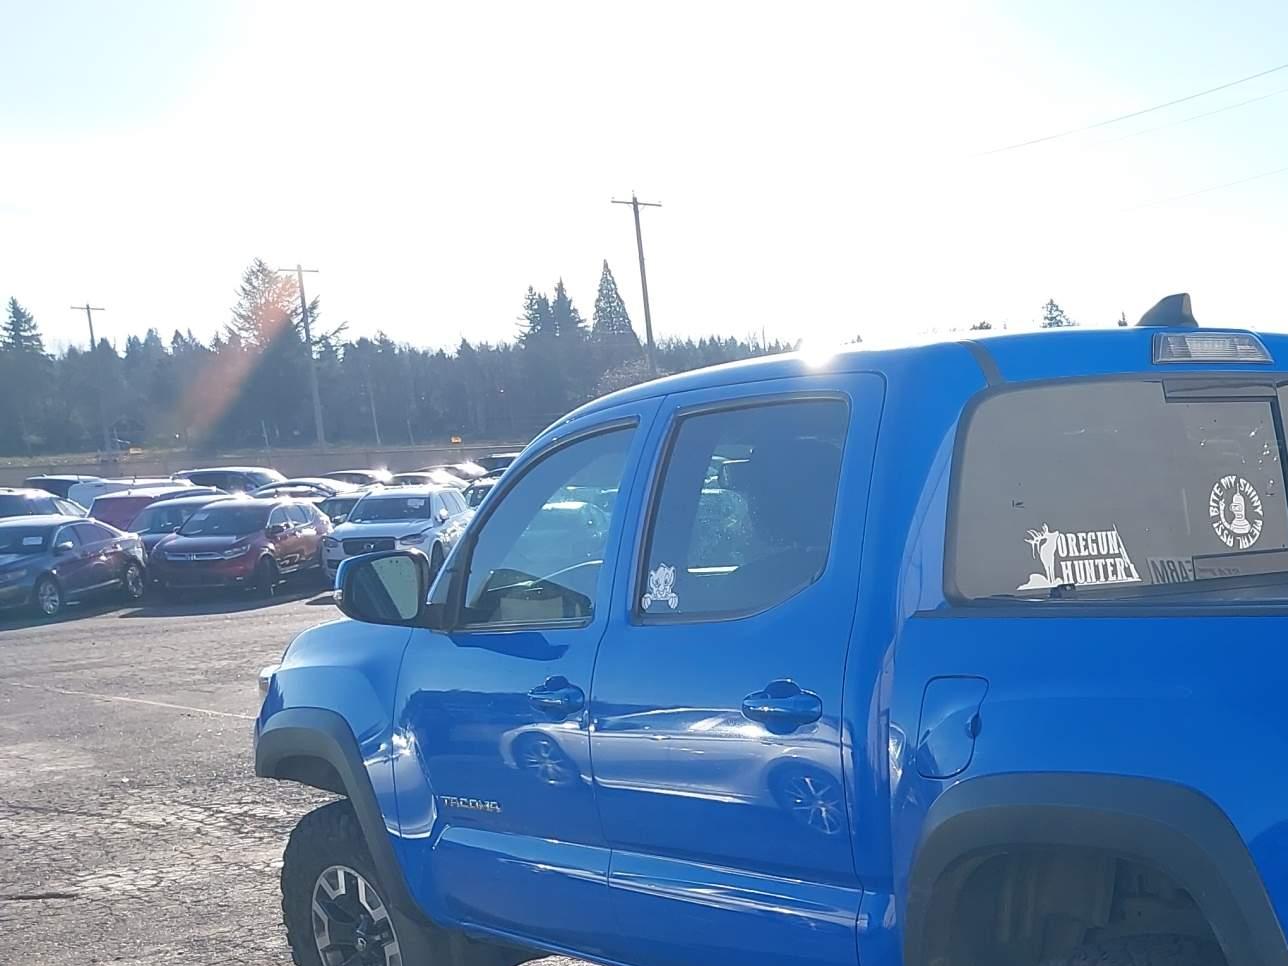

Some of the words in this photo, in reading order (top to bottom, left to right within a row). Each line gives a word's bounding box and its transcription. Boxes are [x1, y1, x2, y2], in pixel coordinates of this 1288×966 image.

[1220, 475, 1237, 489] MY
[1209, 482, 1224, 517] BITE
[1240, 478, 1264, 517] SHINY
[1057, 530, 1120, 557] OREGUN
[1236, 519, 1263, 549] METAL
[1060, 558, 1129, 584] HUNTER
[439, 795, 503, 814] TACOMA
